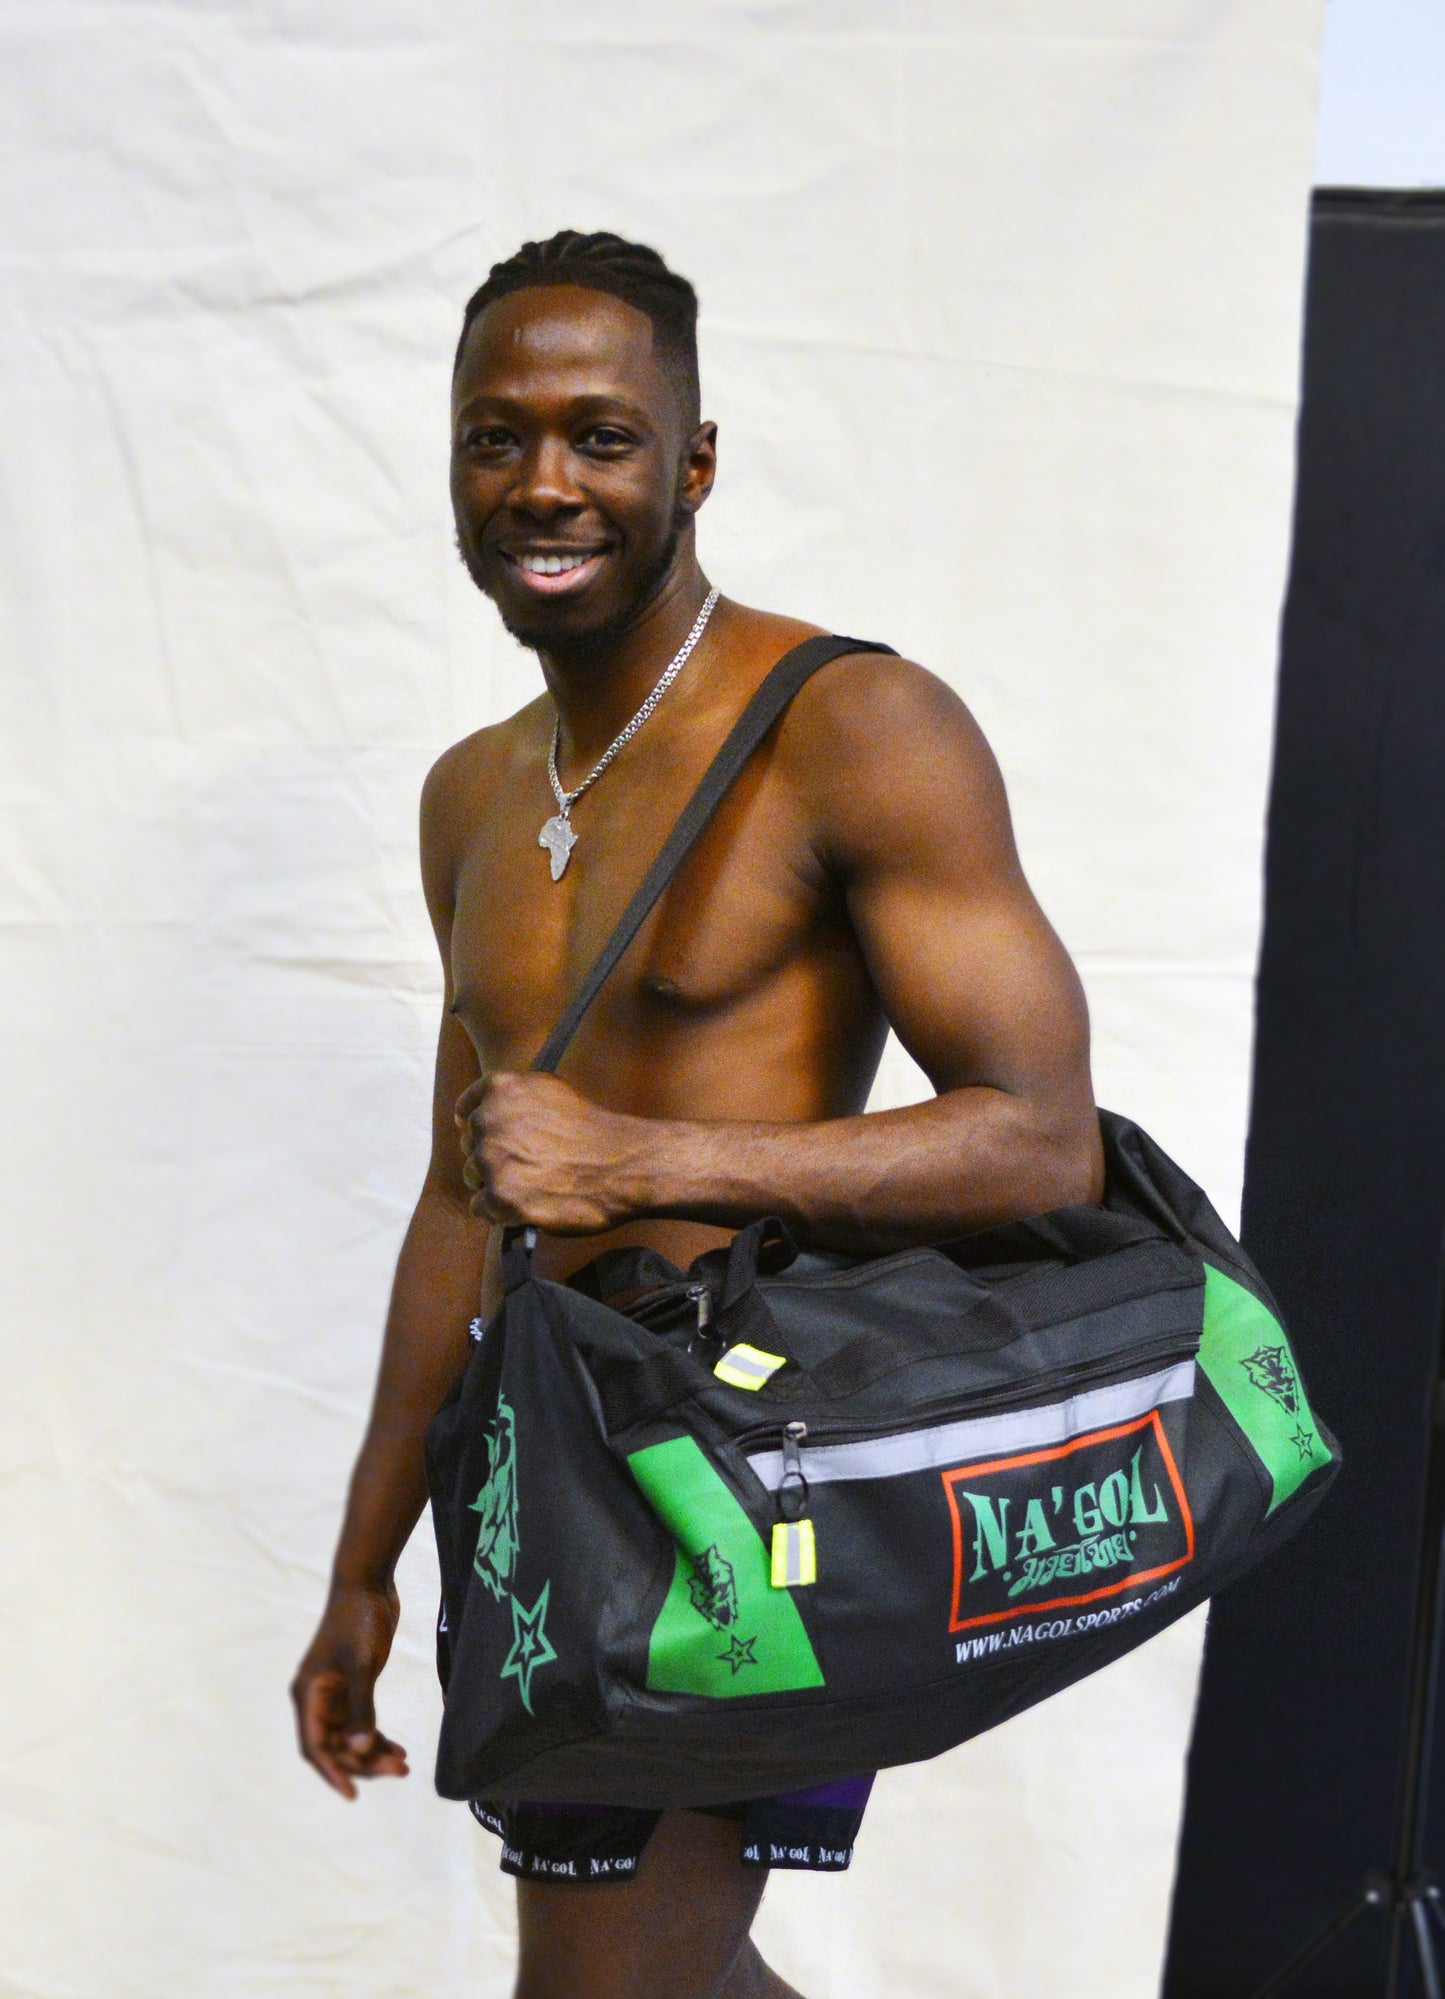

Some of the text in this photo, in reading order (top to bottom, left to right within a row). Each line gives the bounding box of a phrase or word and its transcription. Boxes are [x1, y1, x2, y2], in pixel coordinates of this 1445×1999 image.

[962, 1444, 1169, 1584] NA'GOL
[769, 1843, 810, 1863] NA'GOL
[531, 1856, 577, 1877] NA'GOL
